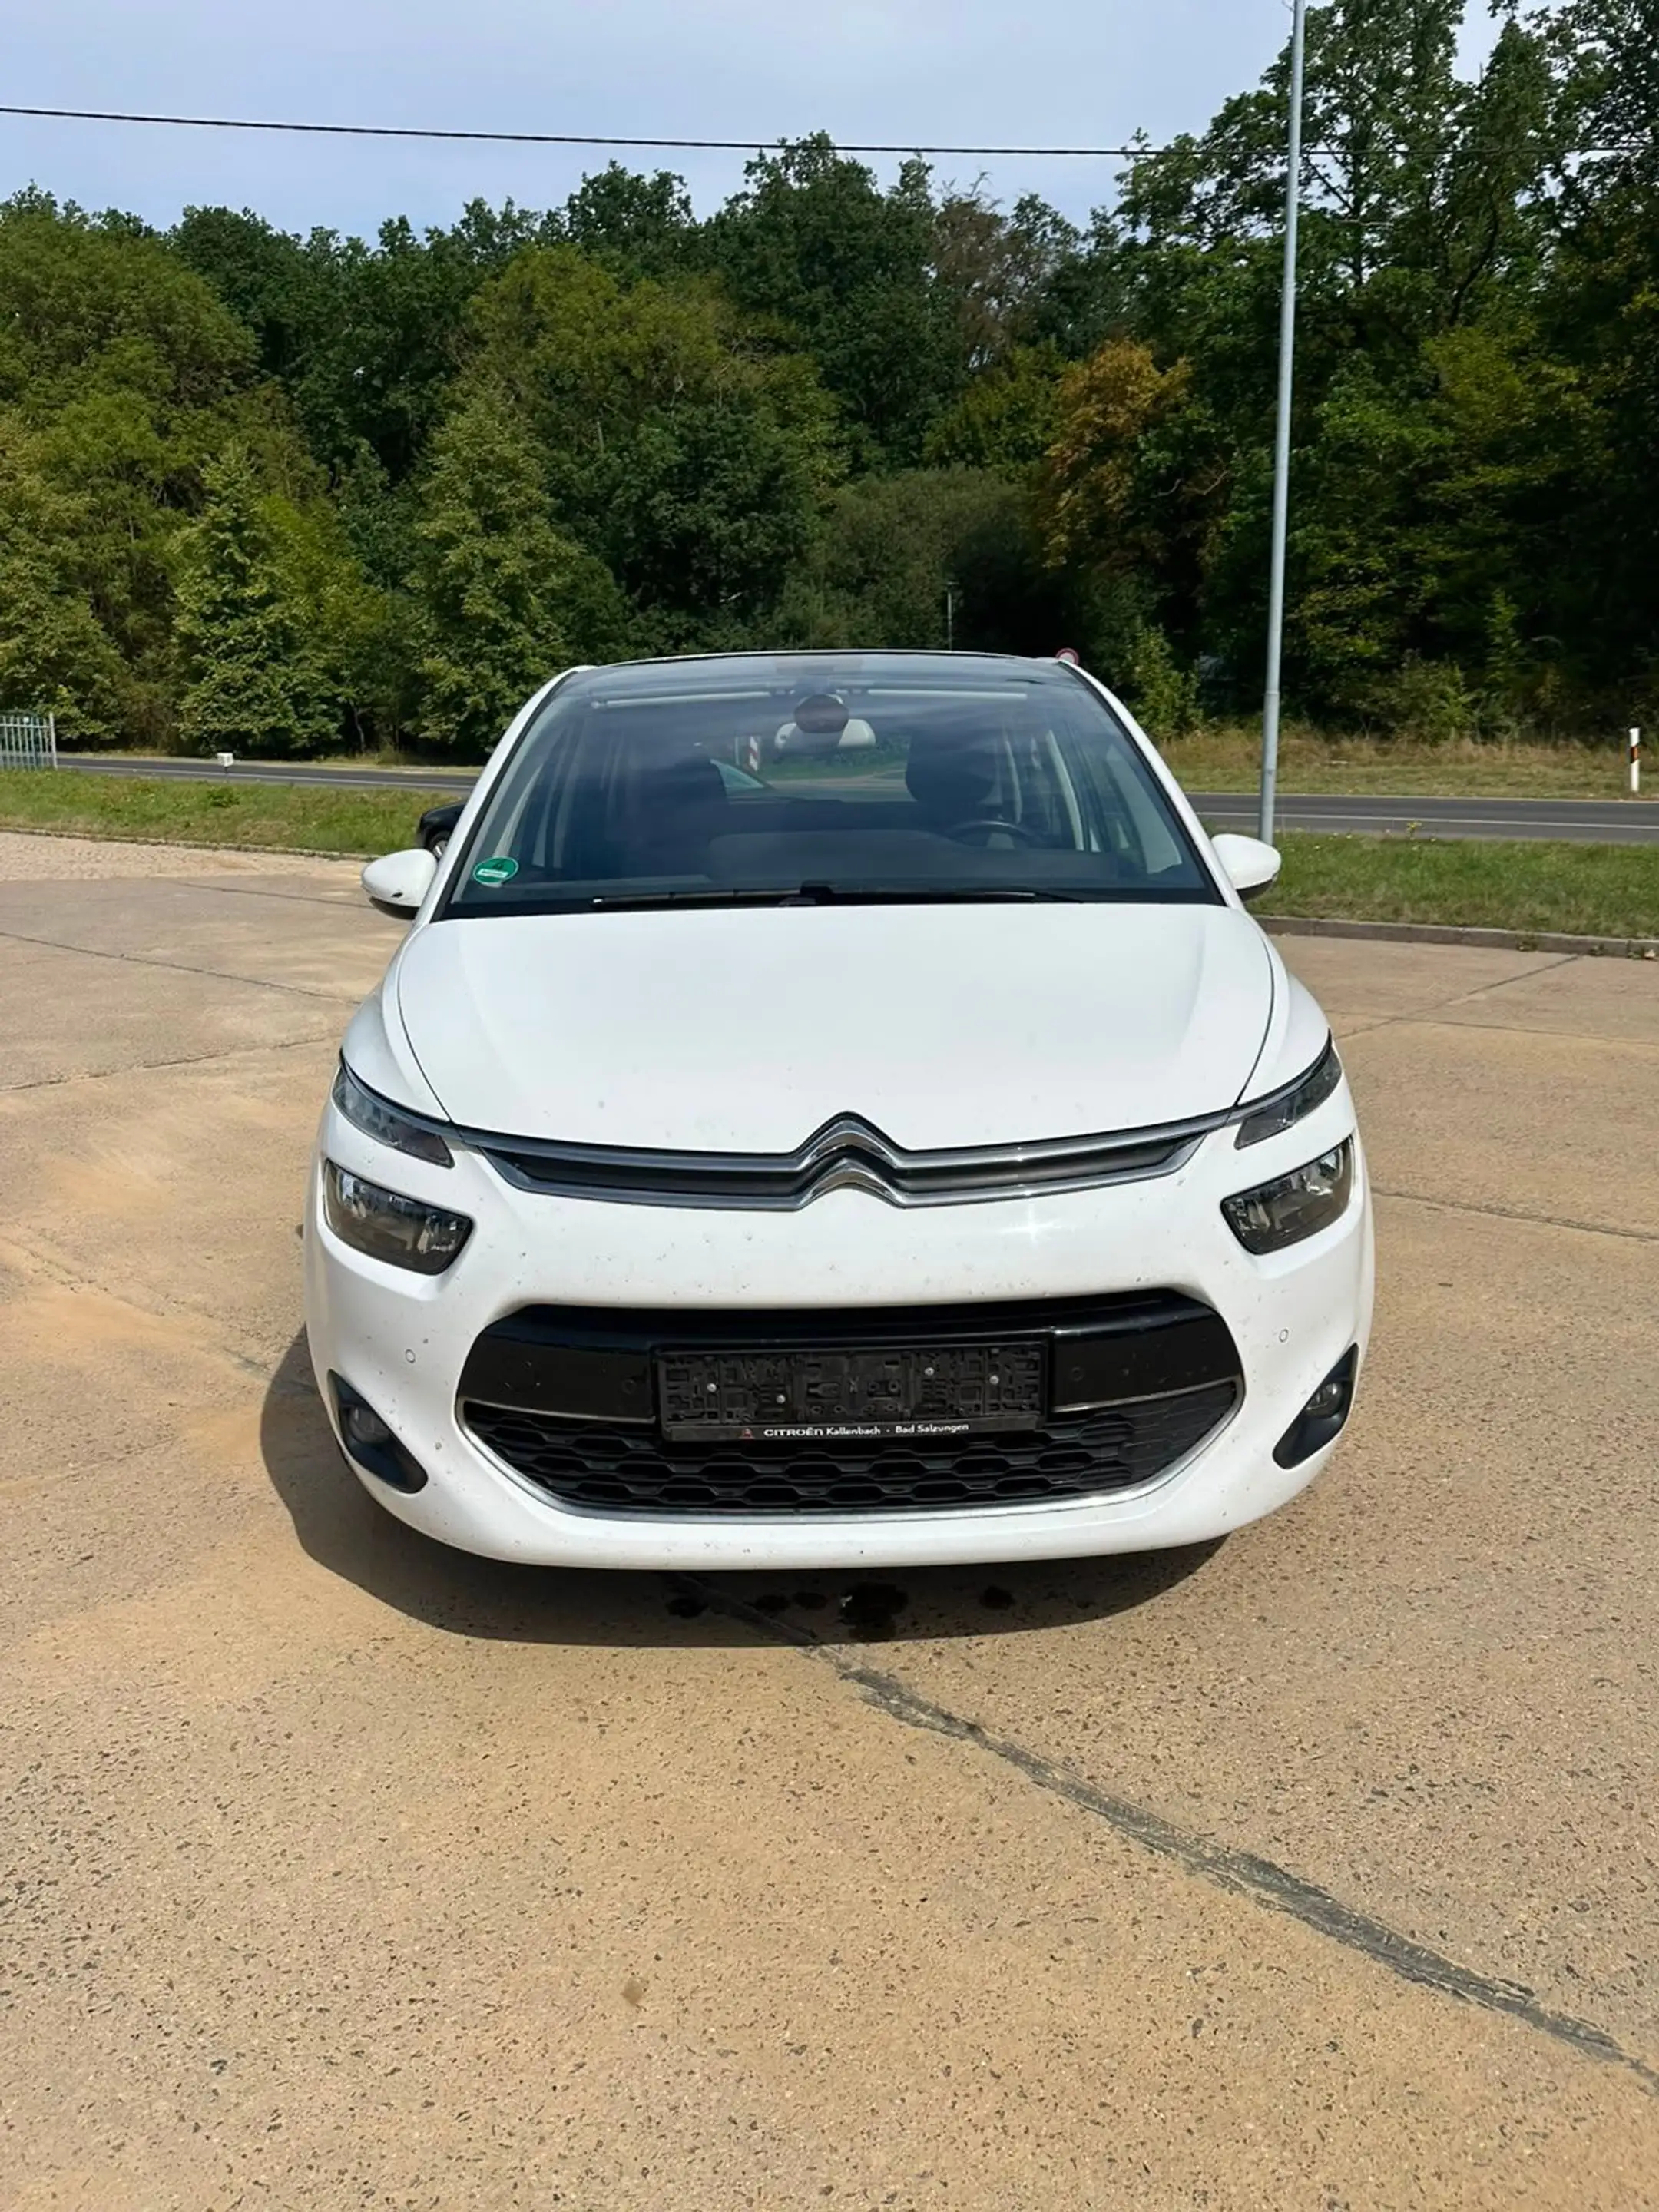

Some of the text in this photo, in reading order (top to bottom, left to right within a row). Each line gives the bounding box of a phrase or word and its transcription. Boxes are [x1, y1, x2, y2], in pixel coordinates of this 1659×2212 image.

[826, 1426, 880, 1435] Kallenbach
[896, 1425, 915, 1434] Bad
[917, 1424, 969, 1433] Salzungen
